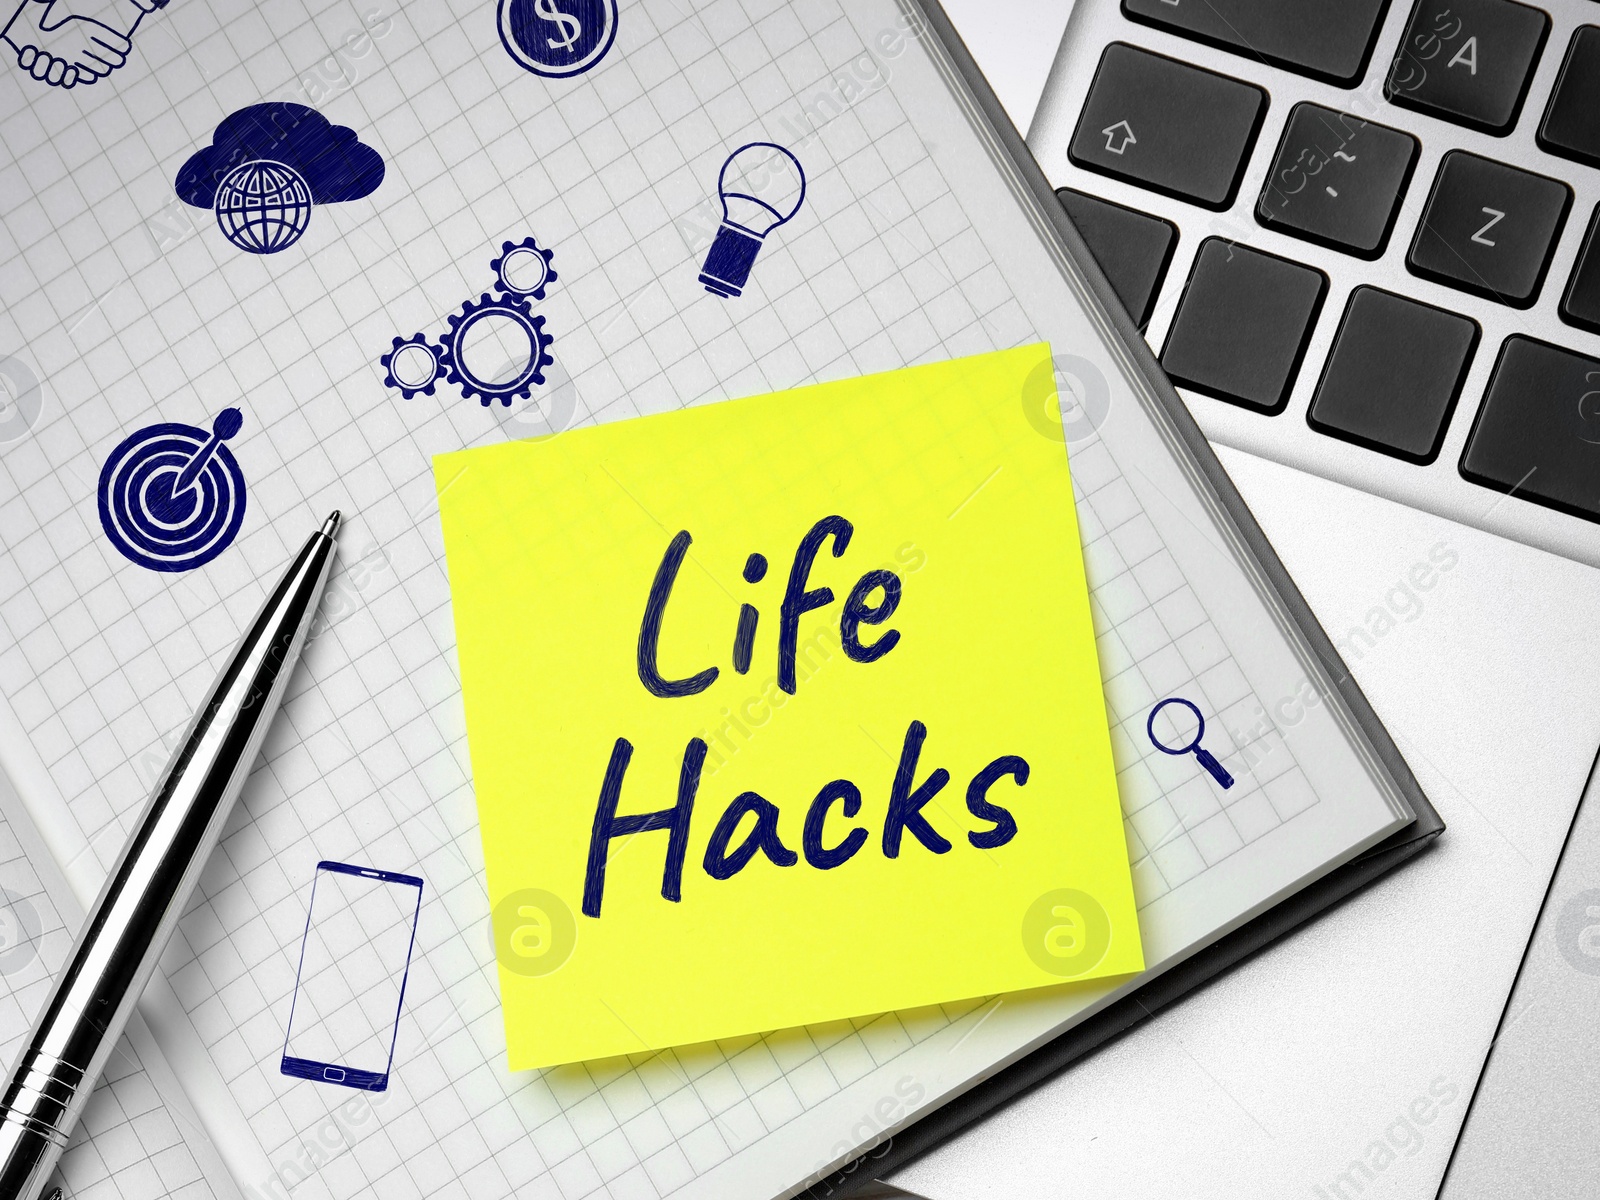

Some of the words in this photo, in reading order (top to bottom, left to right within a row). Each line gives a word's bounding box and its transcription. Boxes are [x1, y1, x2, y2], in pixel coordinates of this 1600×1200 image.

[1447, 36, 1478, 75] A
[1470, 206, 1506, 247] Z
[637, 515, 902, 698] Life
[582, 720, 1030, 919] Hacks
